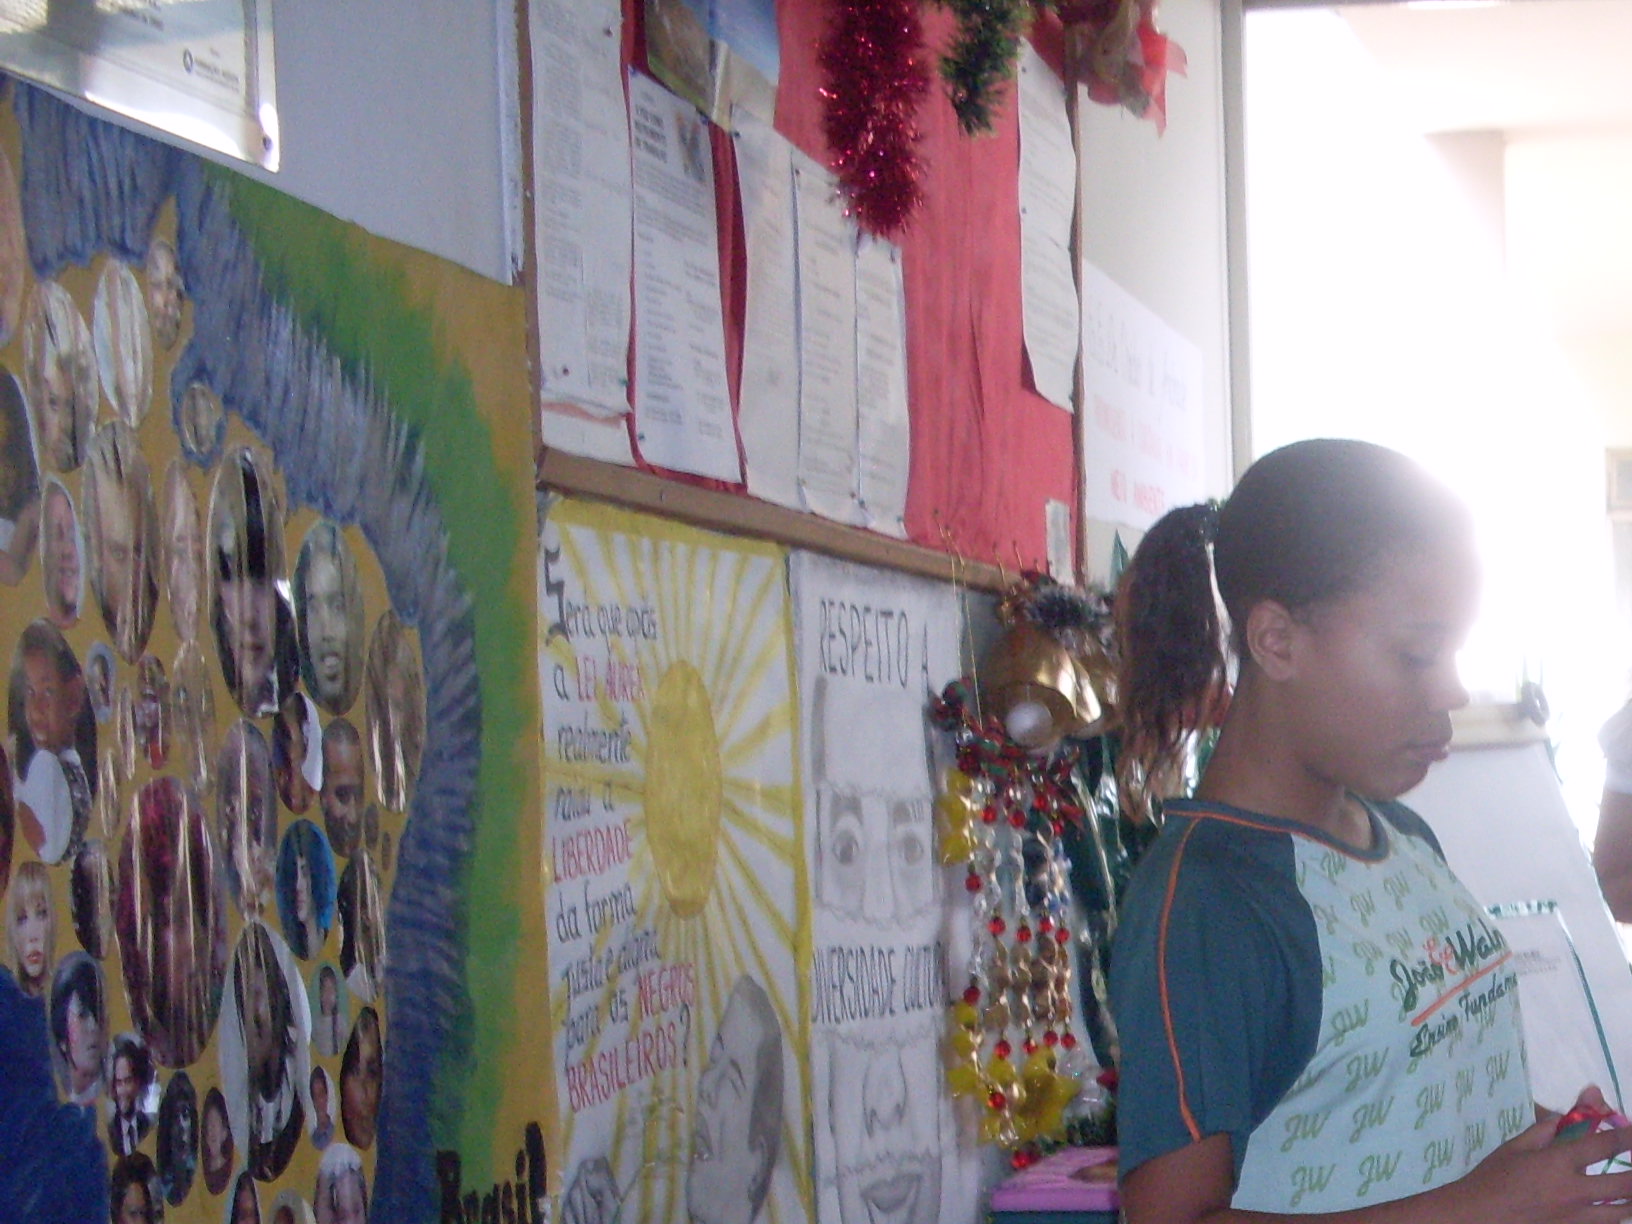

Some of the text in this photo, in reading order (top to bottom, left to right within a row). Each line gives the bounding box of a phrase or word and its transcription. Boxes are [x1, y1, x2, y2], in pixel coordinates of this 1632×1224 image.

[819, 598, 909, 689] RESPEITO
[552, 819, 633, 883] LIBERDADE
[556, 880, 638, 943] da forma
[637, 962, 696, 1022] NEGROS
[1345, 1047, 1390, 1093] JW
[1350, 1096, 1395, 1143] JW
[1416, 1081, 1446, 1130] JW
[1281, 1110, 1332, 1153] JW
[1291, 1164, 1336, 1206] JW
[1357, 1150, 1402, 1197] JW
[1423, 1137, 1455, 1185] JW
